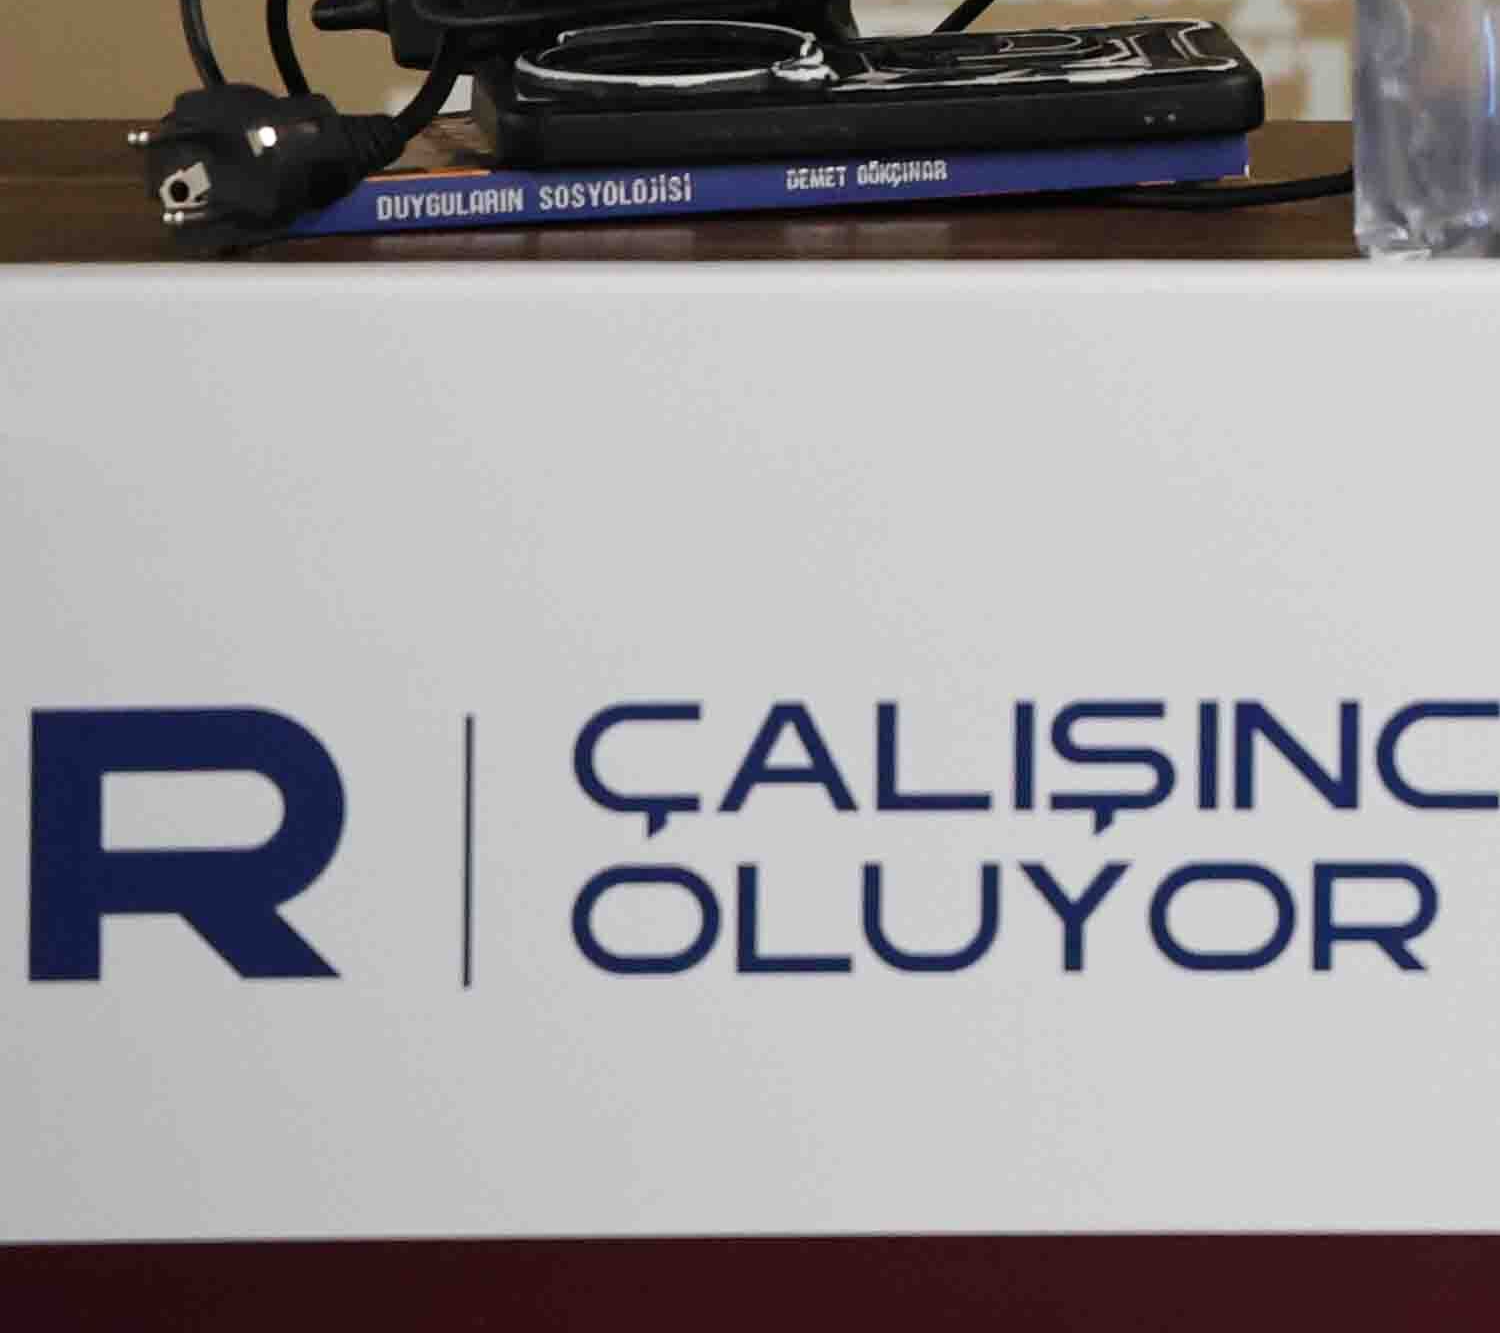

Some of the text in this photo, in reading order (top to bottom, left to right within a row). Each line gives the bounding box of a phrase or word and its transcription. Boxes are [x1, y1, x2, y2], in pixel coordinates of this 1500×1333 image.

[785, 165, 846, 190] DEMET
[376, 188, 524, 221] DUYGULARIN
[573, 861, 1442, 975] OLUYOR
